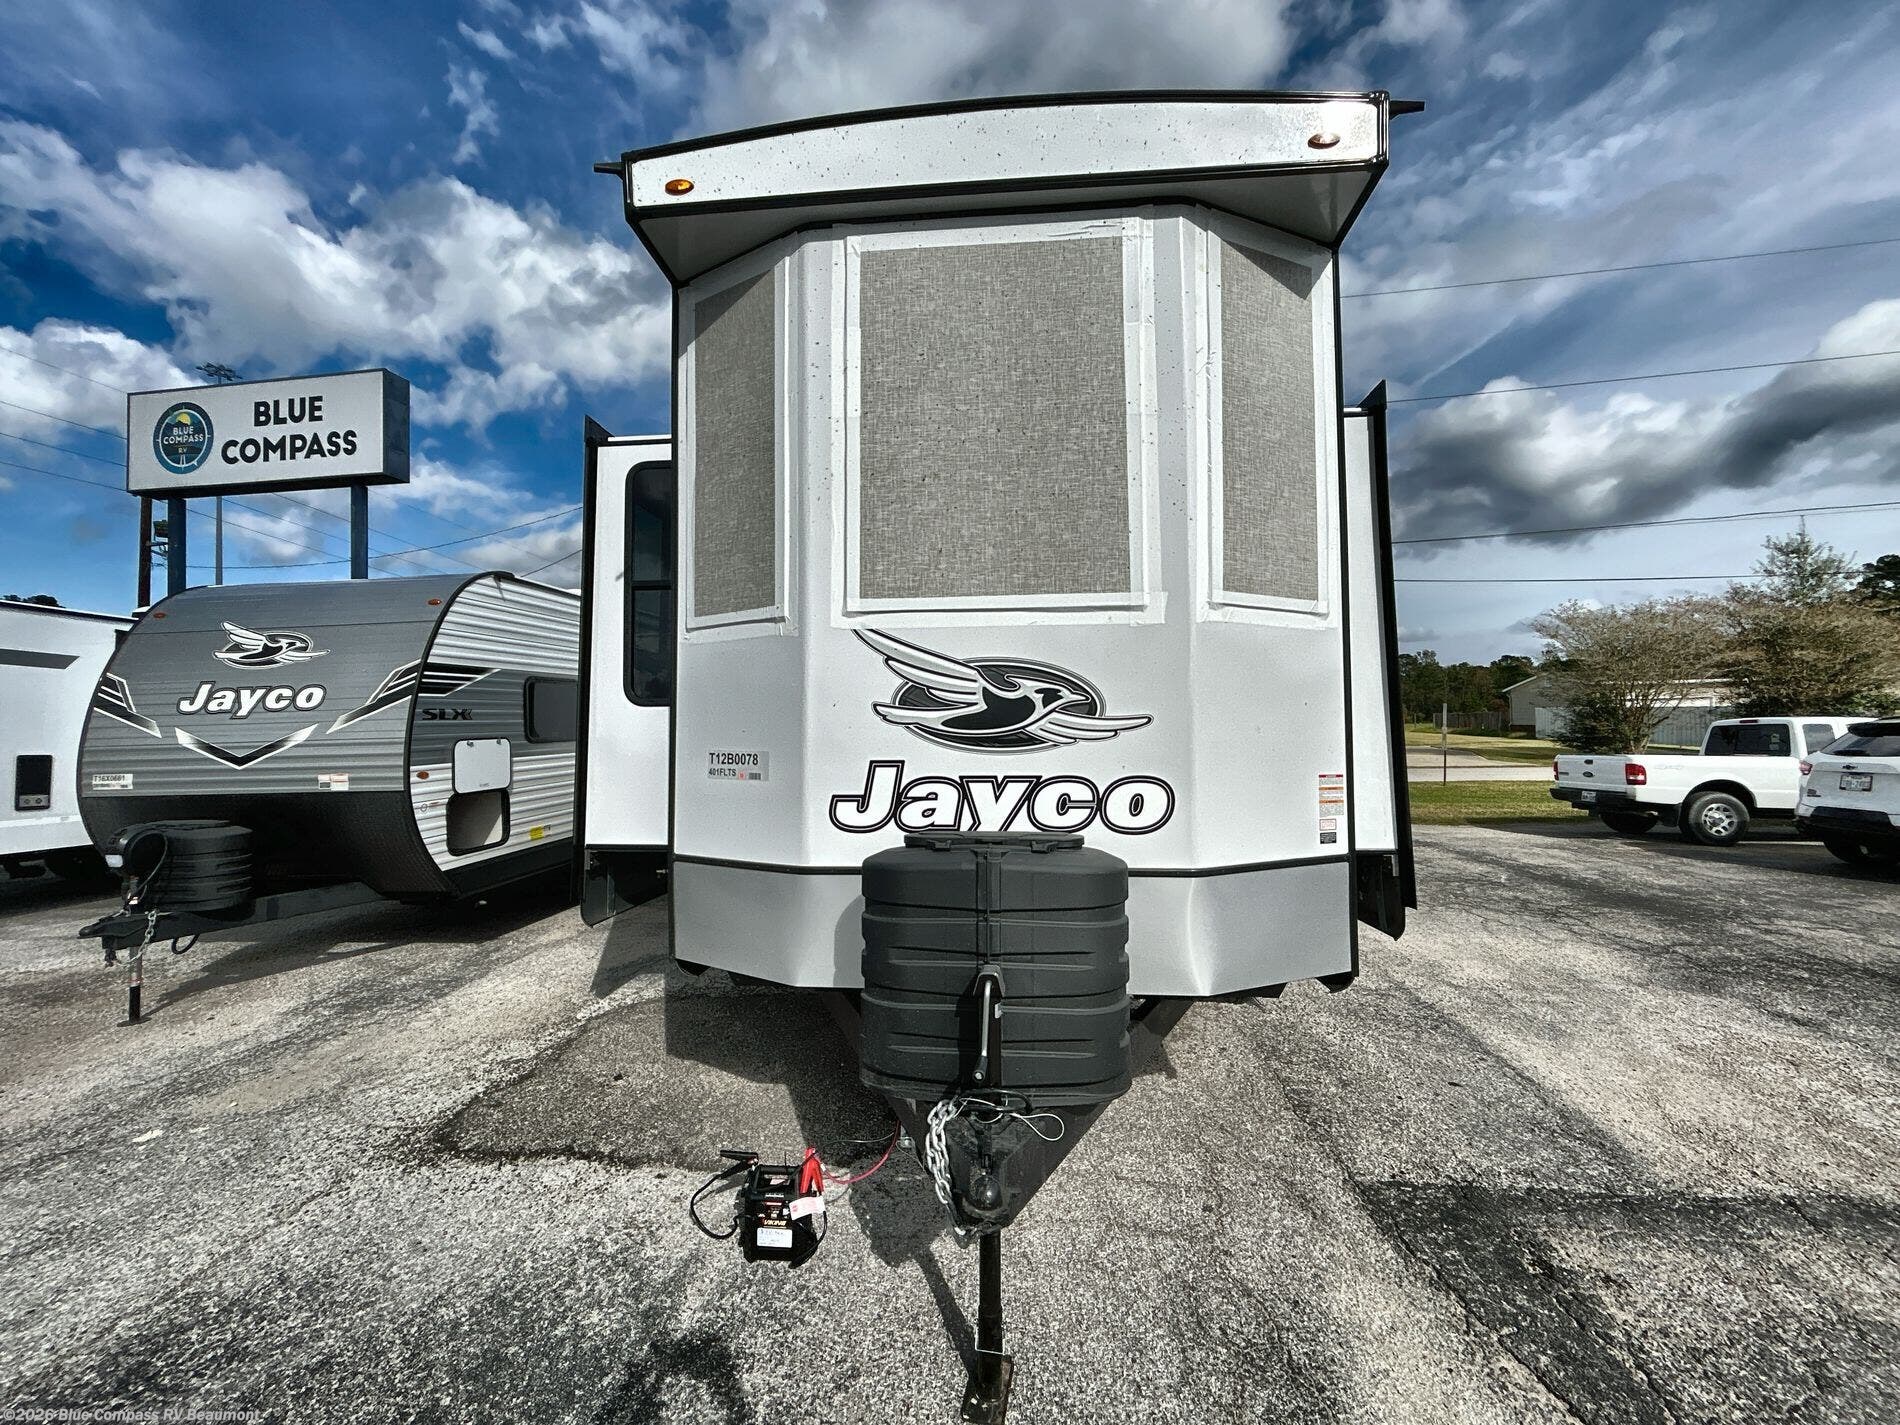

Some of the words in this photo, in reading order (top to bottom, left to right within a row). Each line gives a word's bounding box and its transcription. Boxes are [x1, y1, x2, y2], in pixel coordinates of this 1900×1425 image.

[253, 395, 323, 427] BLUE
[172, 426, 194, 435] BLUE
[163, 433, 204, 445] COMPASS
[220, 429, 358, 465] COMPASS
[176, 680, 327, 720] Jayco
[421, 708, 473, 721] SLX
[709, 752, 759, 766] T12B0078
[708, 768, 737, 777] 401FLTS
[829, 760, 1175, 835] Jayco
